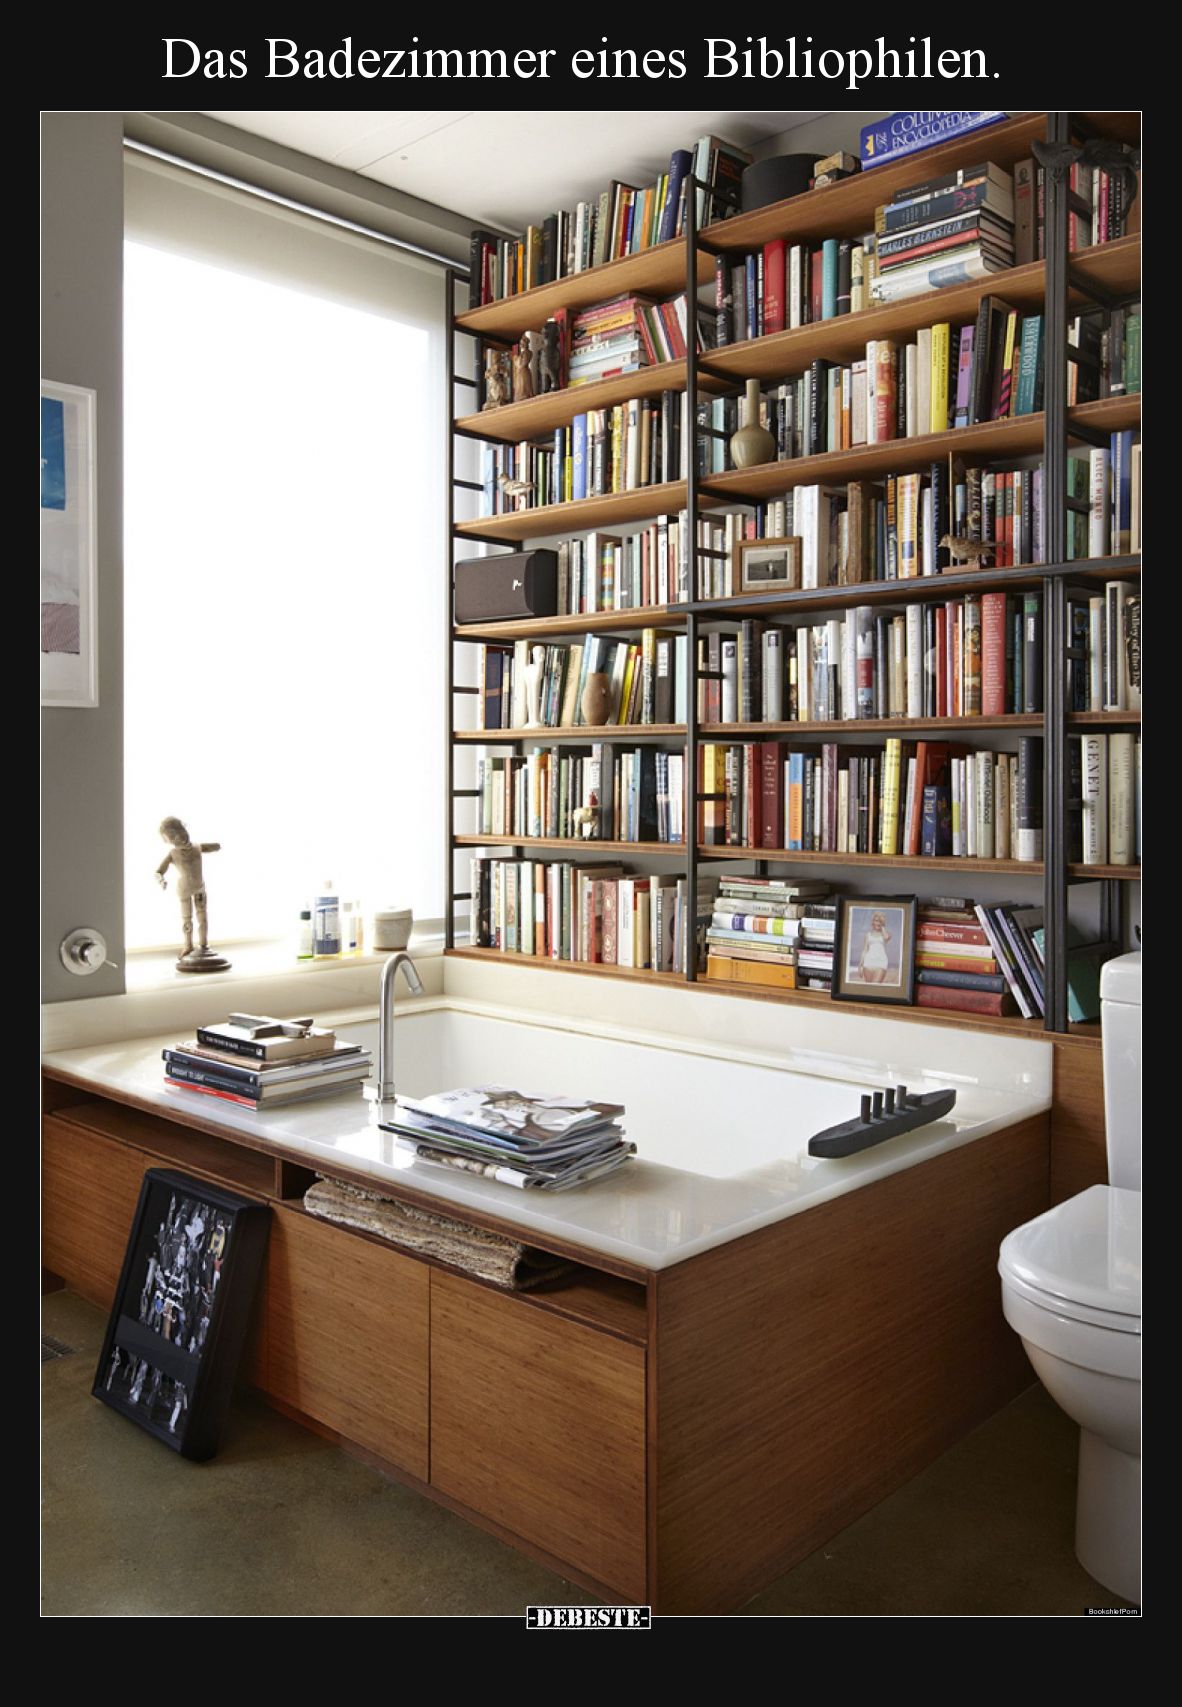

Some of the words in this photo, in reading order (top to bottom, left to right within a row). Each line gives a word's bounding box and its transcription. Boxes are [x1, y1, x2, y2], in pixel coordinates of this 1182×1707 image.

[892, 112, 972, 149] ENCYCLOPEDIA
[1087, 740, 1100, 796] GENET
[983, 790, 991, 825] Childhood
[919, 927, 936, 937] John
[936, 929, 964, 940] Cheever
